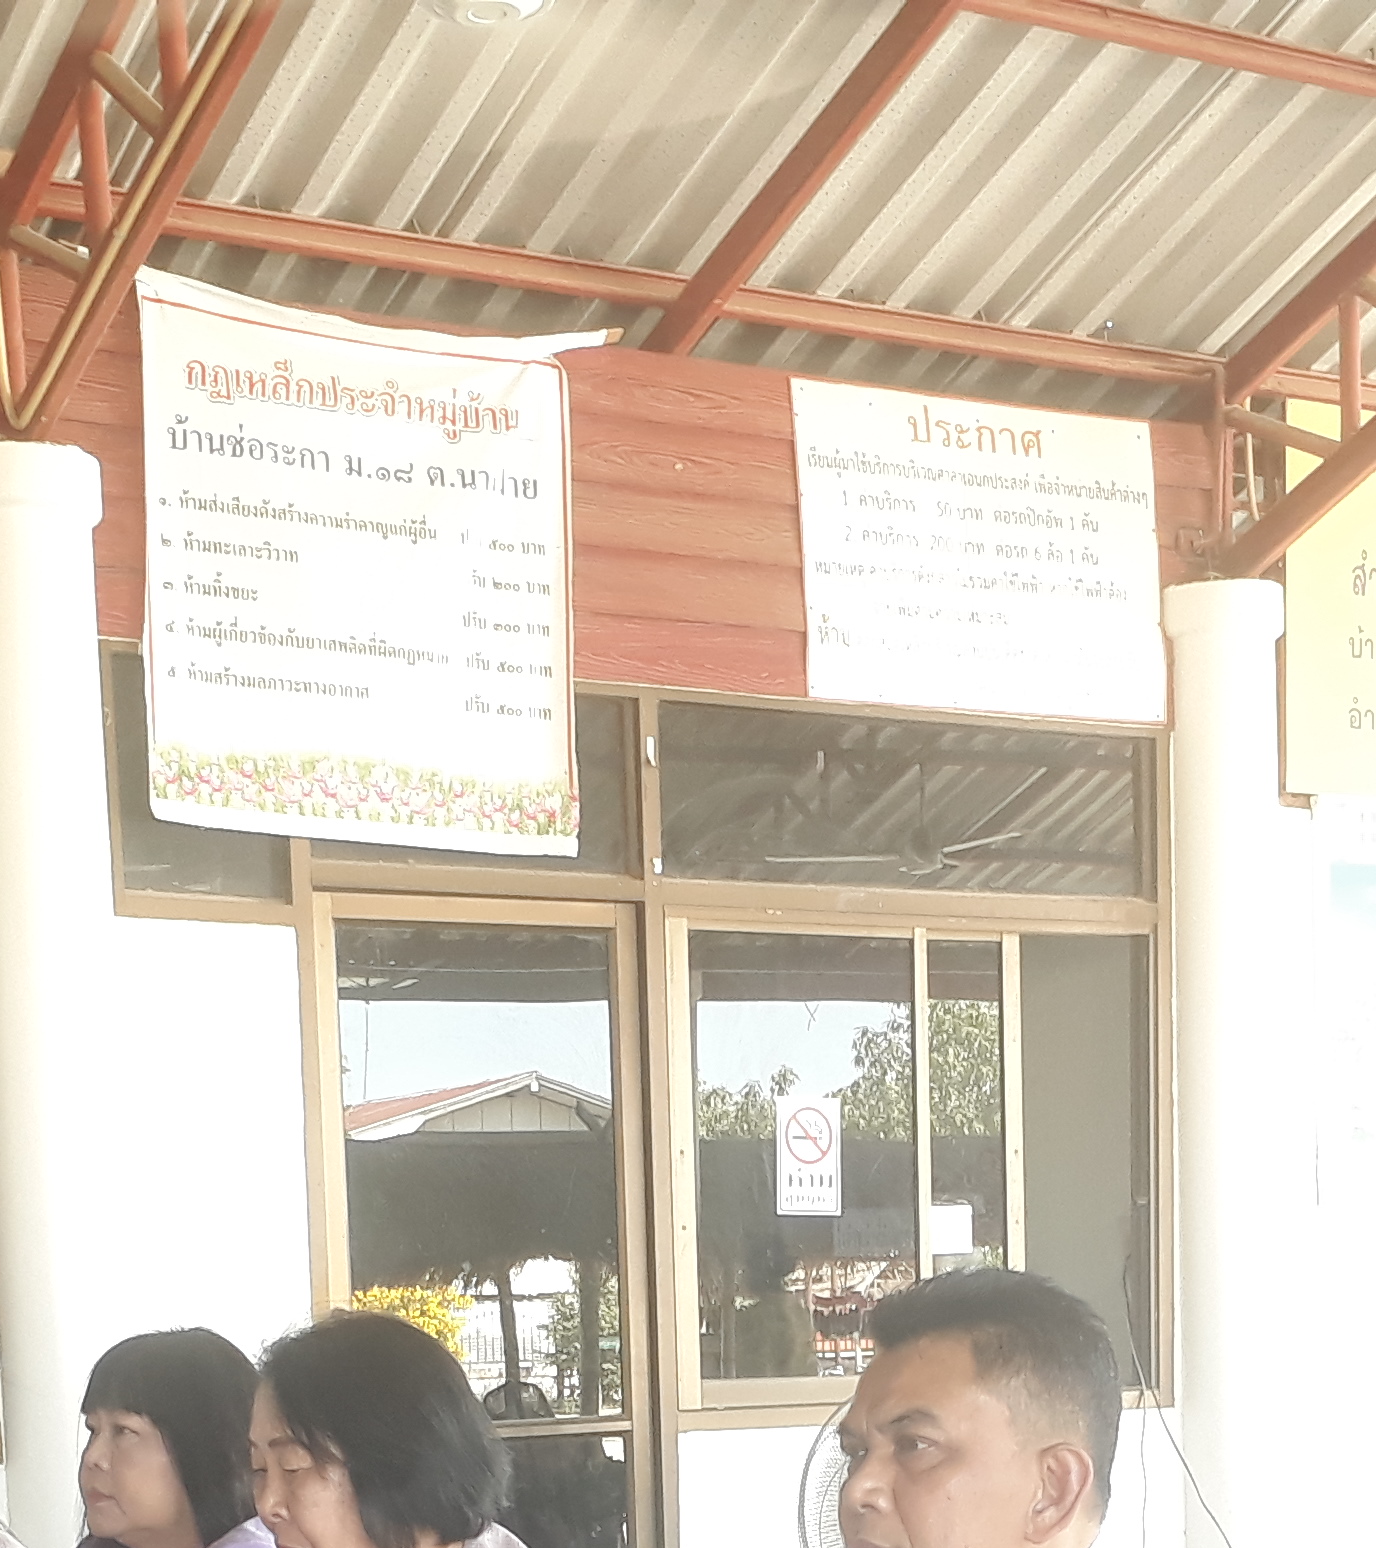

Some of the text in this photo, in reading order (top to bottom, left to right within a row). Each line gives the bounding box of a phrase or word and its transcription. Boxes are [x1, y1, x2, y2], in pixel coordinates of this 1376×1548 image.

[167, 414, 330, 472] บ้านช่อระกา
[907, 404, 1042, 459] ประกาศ
